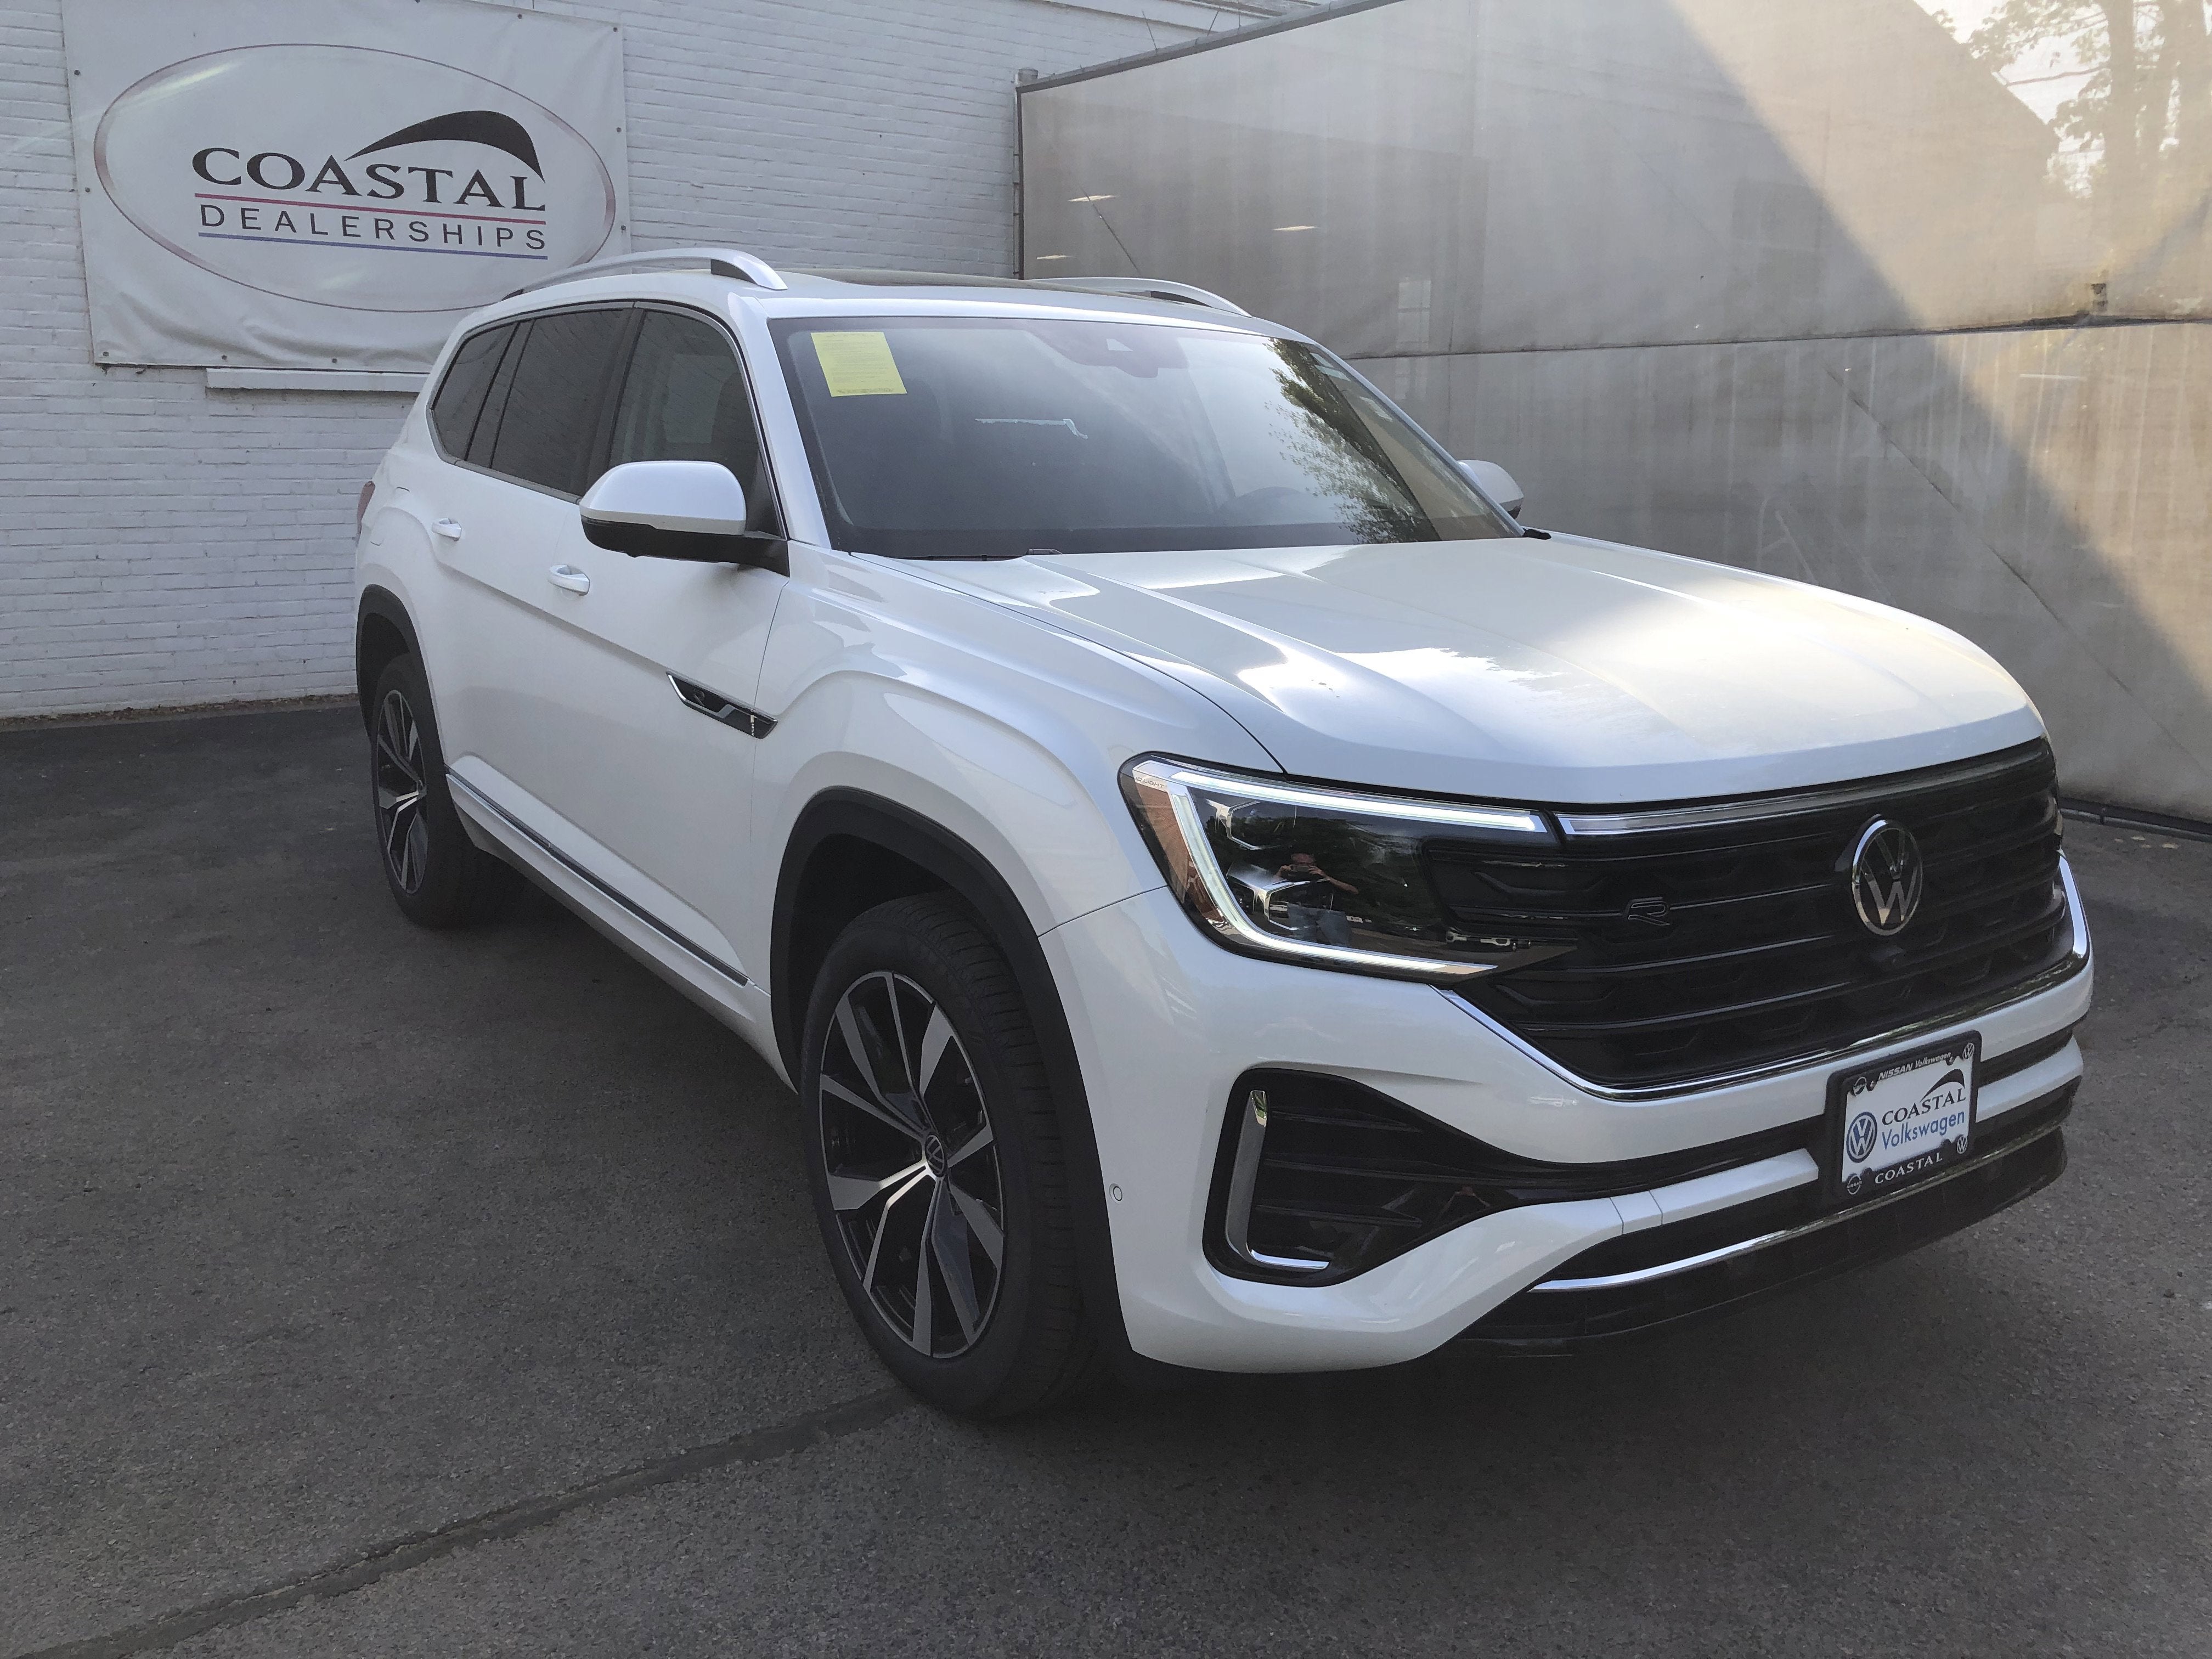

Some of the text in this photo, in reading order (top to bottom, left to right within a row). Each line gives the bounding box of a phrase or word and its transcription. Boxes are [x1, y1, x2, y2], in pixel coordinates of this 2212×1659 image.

[191, 147, 546, 212] COASTAL
[200, 204, 545, 250] DEALERSHIPS
[1878, 1063, 1913, 1080] NISSAN
[1882, 1088, 1966, 1125] COASTAL
[1882, 1111, 1965, 1150] Volkswagen
[1875, 1152, 1943, 1184] COASTAL
